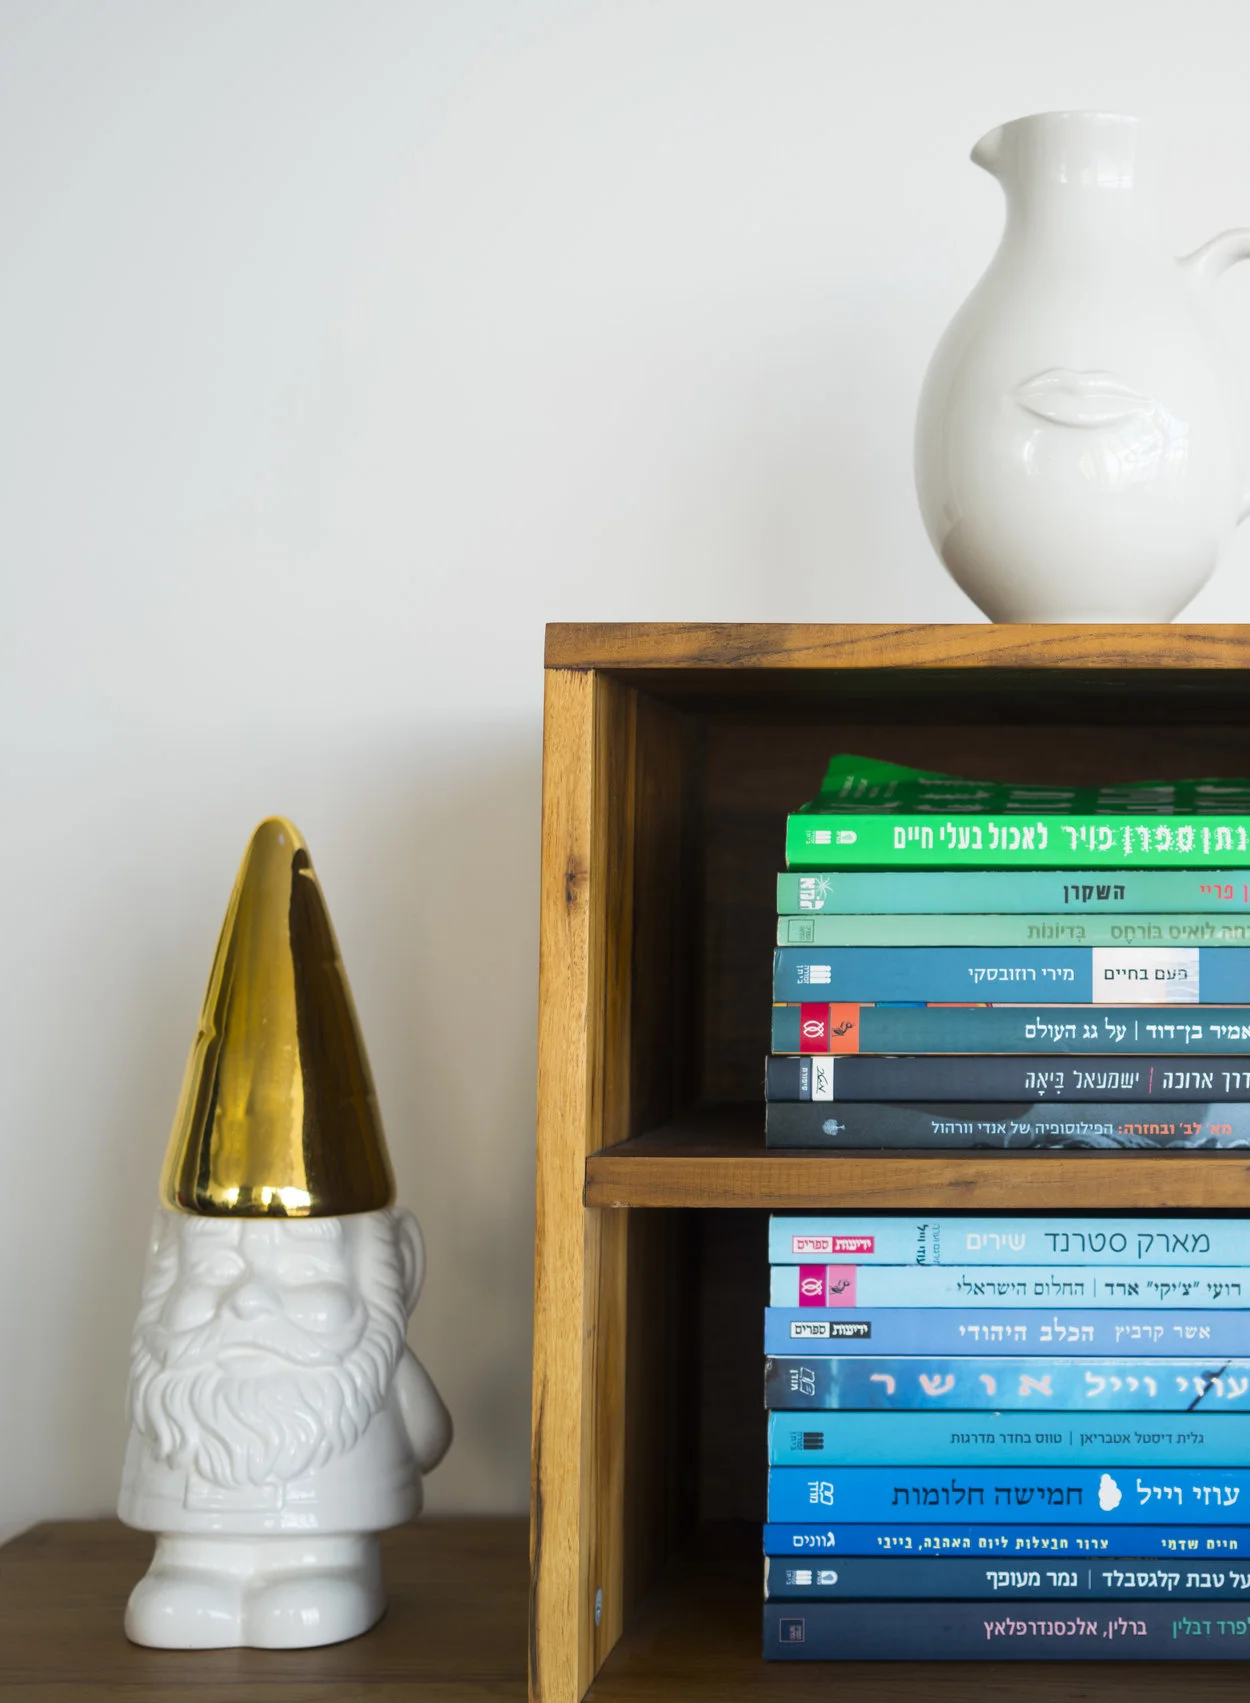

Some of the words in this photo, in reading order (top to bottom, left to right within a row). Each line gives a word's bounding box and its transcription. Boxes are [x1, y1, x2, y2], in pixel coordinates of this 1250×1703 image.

[893, 826, 934, 850] חיים
[939, 822, 983, 850] בעלי
[988, 822, 1049, 850] לאכול
[1060, 825, 1117, 851] פויר
[1063, 884, 1126, 904] השקרן
[1199, 885, 1234, 900] פריי
[1168, 920, 1216, 940] לואיס
[968, 967, 1036, 985] רוזובסקי
[1041, 967, 1075, 981] מירי
[1103, 967, 1149, 981] בחיים
[1154, 967, 1188, 981] פעם
[1024, 1016, 1077, 1043] העולם
[1082, 1024, 1098, 1040] גג
[1105, 1016, 1127, 1043] על
[1072, 1070, 1140, 1090] ישמעאל
[1162, 1071, 1214, 1090] ארוכה
[931, 1120, 974, 1135] וורהול
[977, 1122, 1007, 1135] אנדי
[1010, 1120, 1031, 1135] של
[1035, 1120, 1114, 1136] הפילוסופיה
[1117, 1122, 1176, 1136] ובחזרה:
[915, 1224, 930, 1243] וייל
[966, 1233, 1026, 1251] שירים
[796, 1238, 830, 1250] ספרים
[834, 1238, 872, 1252] ידיעות
[1044, 1233, 1128, 1252] סטרנד
[1137, 1233, 1211, 1259] מארק
[956, 1275, 1028, 1296] הישראלי
[1033, 1274, 1085, 1296] החלום
[1104, 1281, 1140, 1296] ארד
[1206, 1281, 1242, 1299] רועי
[794, 1323, 827, 1336] ספרים
[831, 1323, 869, 1337] ידיעות
[958, 1325, 1028, 1341] היהודי
[1039, 1316, 1094, 1342] הכלב
[1114, 1325, 1164, 1342] קרביץ
[1173, 1326, 1211, 1340] אשר
[789, 1368, 800, 1392] מודן
[1084, 1370, 1157, 1398] וייל
[950, 1432, 996, 1445] מדרגות
[999, 1432, 1032, 1445] בחדר
[1035, 1433, 1062, 1444] טווס
[1079, 1432, 1131, 1447] אטבריאן
[1134, 1431, 1172, 1445] דיסטל
[1176, 1431, 1204, 1445] גלית
[808, 1480, 820, 1504] מודן
[891, 1478, 985, 1506] חלומות
[994, 1486, 1083, 1506] חמישה
[1136, 1478, 1184, 1506] וייל
[1192, 1486, 1240, 1506] עוזי
[792, 1531, 836, 1548] גוונים
[876, 1536, 913, 1550] בייבי
[917, 1536, 972, 1551] האהבה,
[977, 1536, 1009, 1551] ליום
[1014, 1536, 1069, 1551] חבצלות
[1075, 1538, 1110, 1551] צרור
[1160, 1538, 1199, 1552] שדמי
[1206, 1538, 1239, 1551] חיים
[986, 1571, 1042, 1591] מעופף
[1046, 1571, 1079, 1588] נמר
[1102, 1568, 1181, 1592] קלגסבלד
[1185, 1573, 1226, 1588] טבת
[983, 1617, 1098, 1641] אלכסנדרפלאץ
[1103, 1617, 1148, 1640] ברלין,
